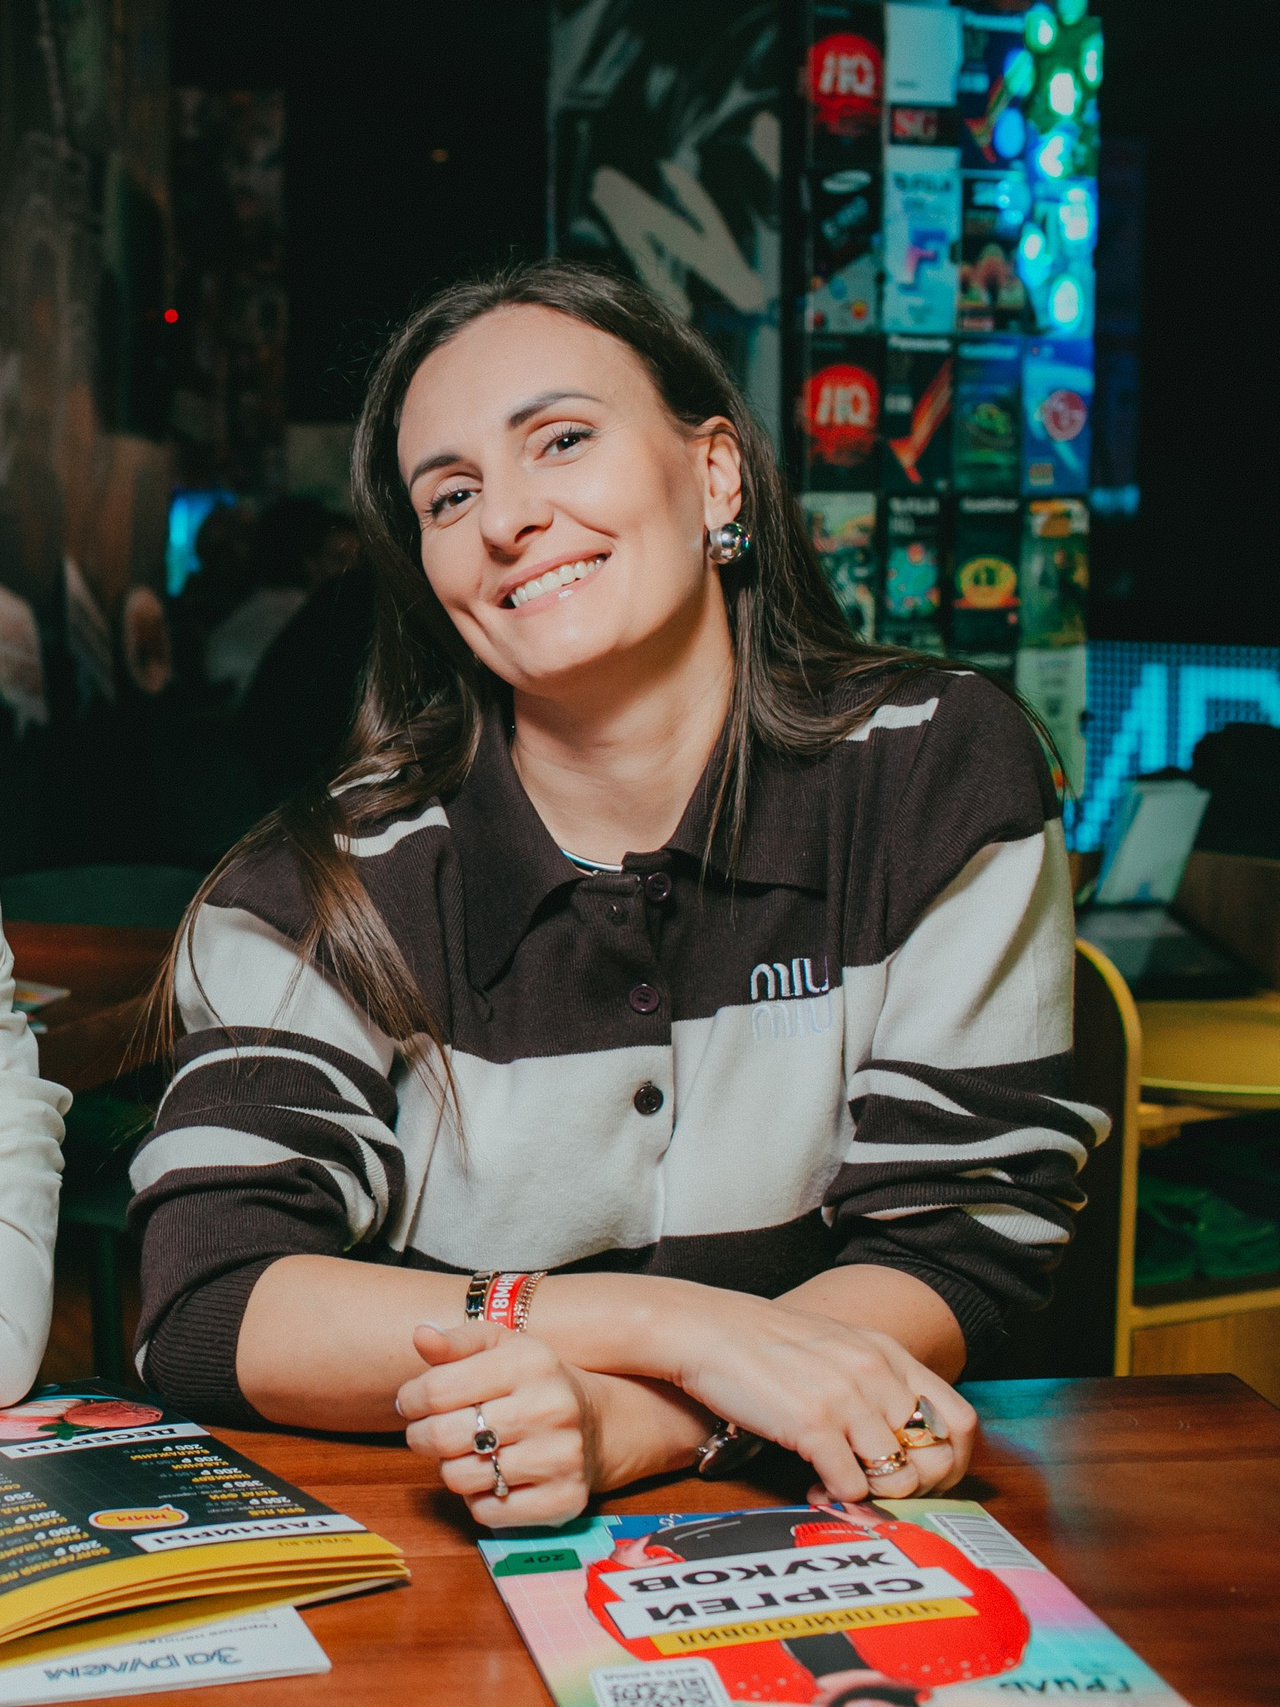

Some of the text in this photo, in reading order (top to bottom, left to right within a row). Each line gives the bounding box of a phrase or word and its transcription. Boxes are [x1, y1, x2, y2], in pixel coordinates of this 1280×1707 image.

[17, 1426, 176, 1454] ДЕСЕРТЫ
[207, 1492, 239, 1500] ФРИ
[260, 1496, 291, 1504] 200
[27, 1509, 60, 1521] 200
[274, 1506, 305, 1514] ФРИ
[47, 1524, 81, 1537] 200
[154, 1519, 331, 1546] ГАРНИРЫ
[66, 1539, 101, 1553] 200
[635, 1551, 898, 1593] ЖУКОВ
[648, 1577, 925, 1623] СЕРГЕЙ
[677, 1603, 941, 1645] ЧТО ПРИГОТОВИЛ
